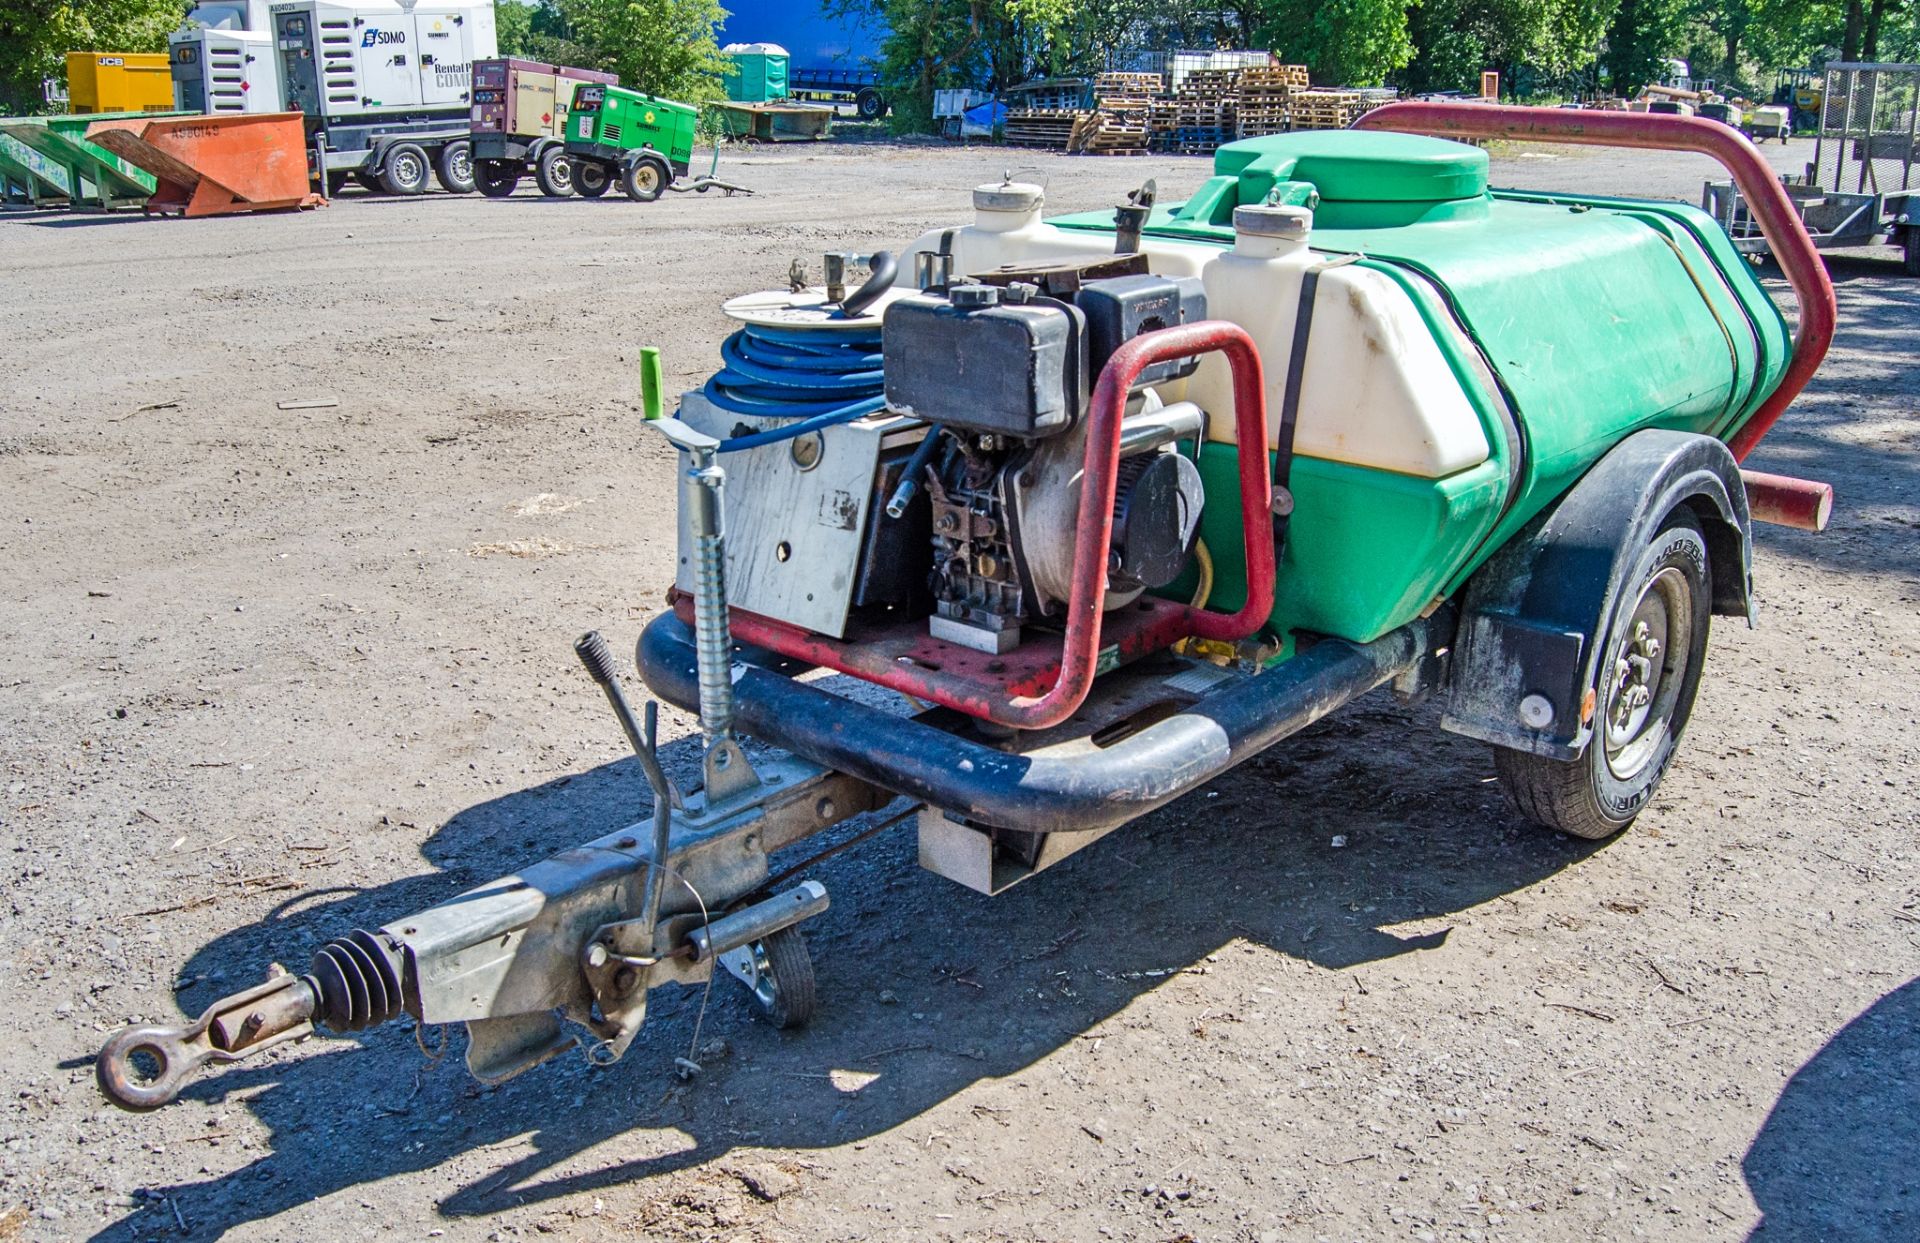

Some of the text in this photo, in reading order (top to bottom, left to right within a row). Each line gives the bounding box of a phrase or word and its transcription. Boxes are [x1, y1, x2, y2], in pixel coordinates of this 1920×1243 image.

[378, 31, 406, 45] SDMO
[98, 58, 124, 66] JCB
[435, 62, 464, 74] Rental
